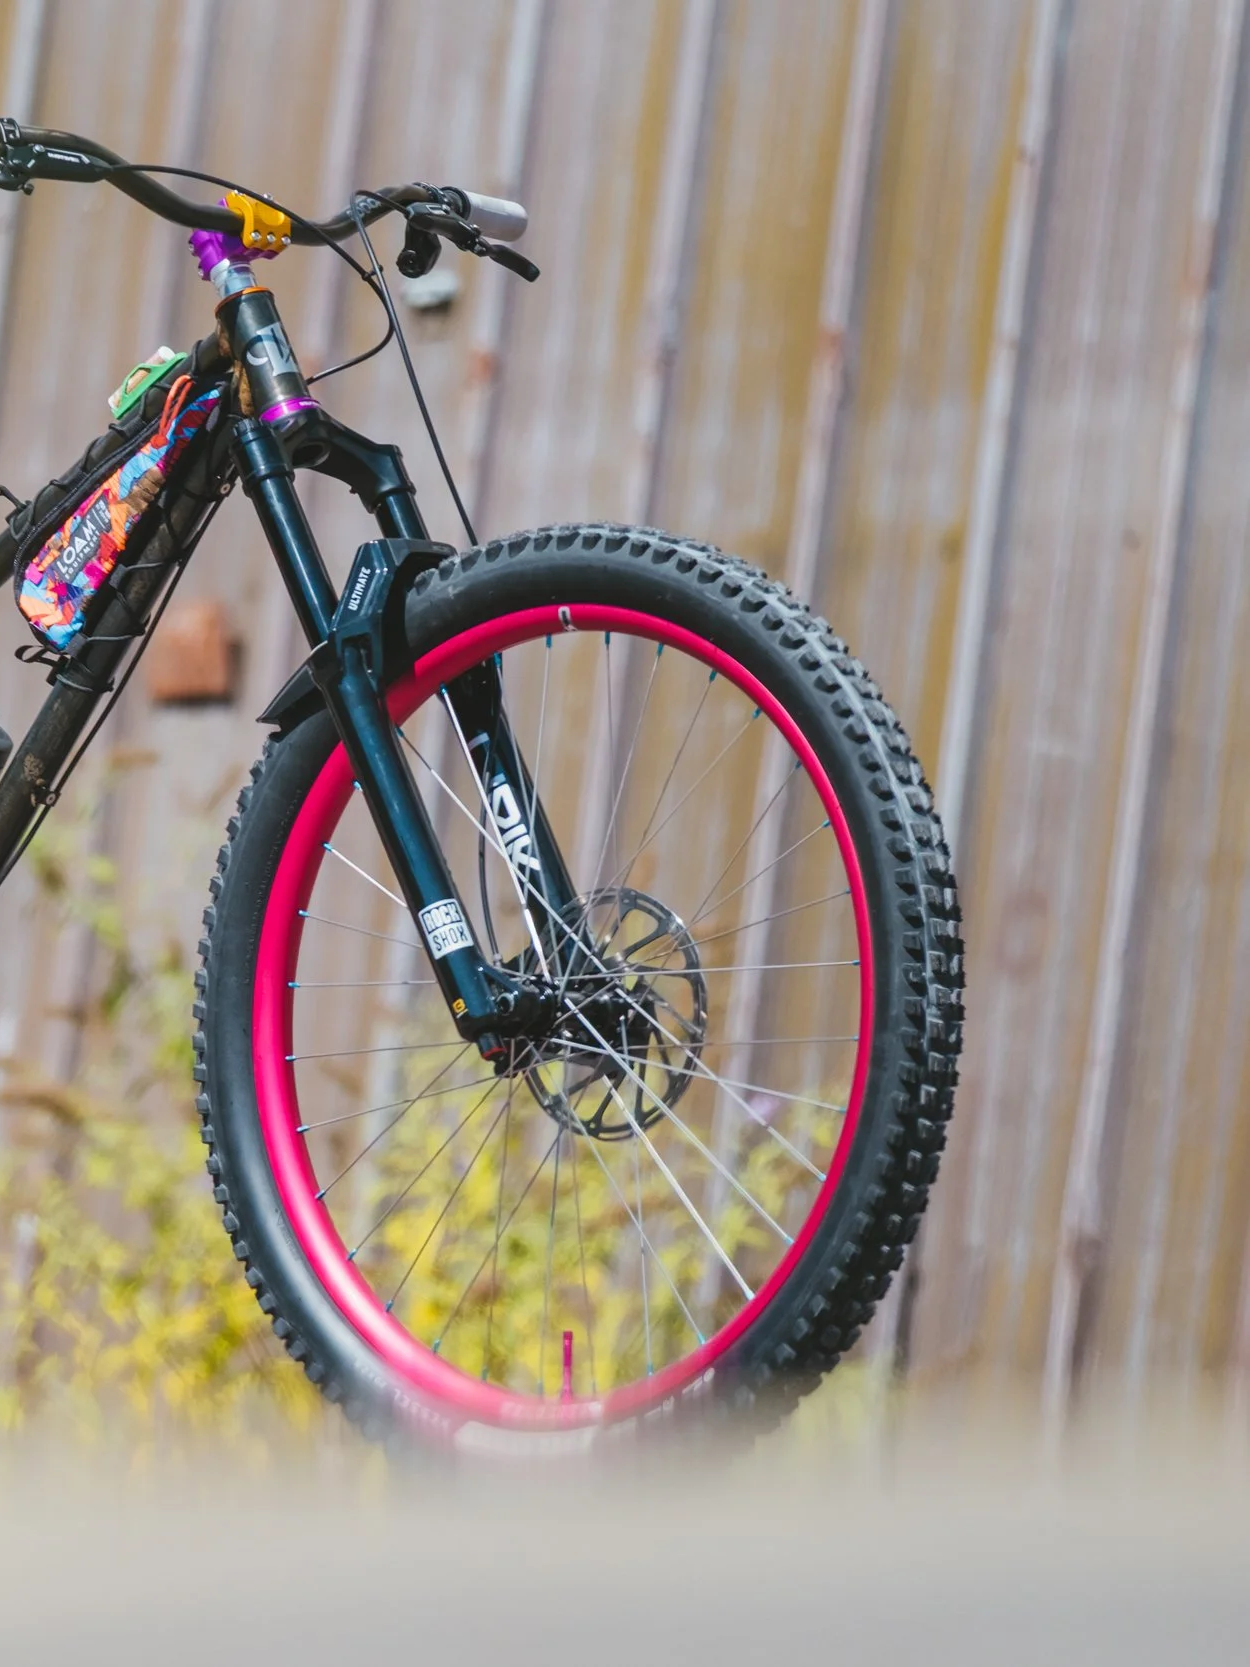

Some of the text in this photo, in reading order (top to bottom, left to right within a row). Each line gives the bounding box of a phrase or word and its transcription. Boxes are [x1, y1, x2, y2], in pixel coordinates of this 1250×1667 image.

[57, 517, 100, 575] LOAM
[65, 529, 100, 579] EQUIPMENT
[347, 566, 371, 611] ULTIMATE
[421, 903, 462, 933] ROCK
[432, 924, 469, 952] SHOX
